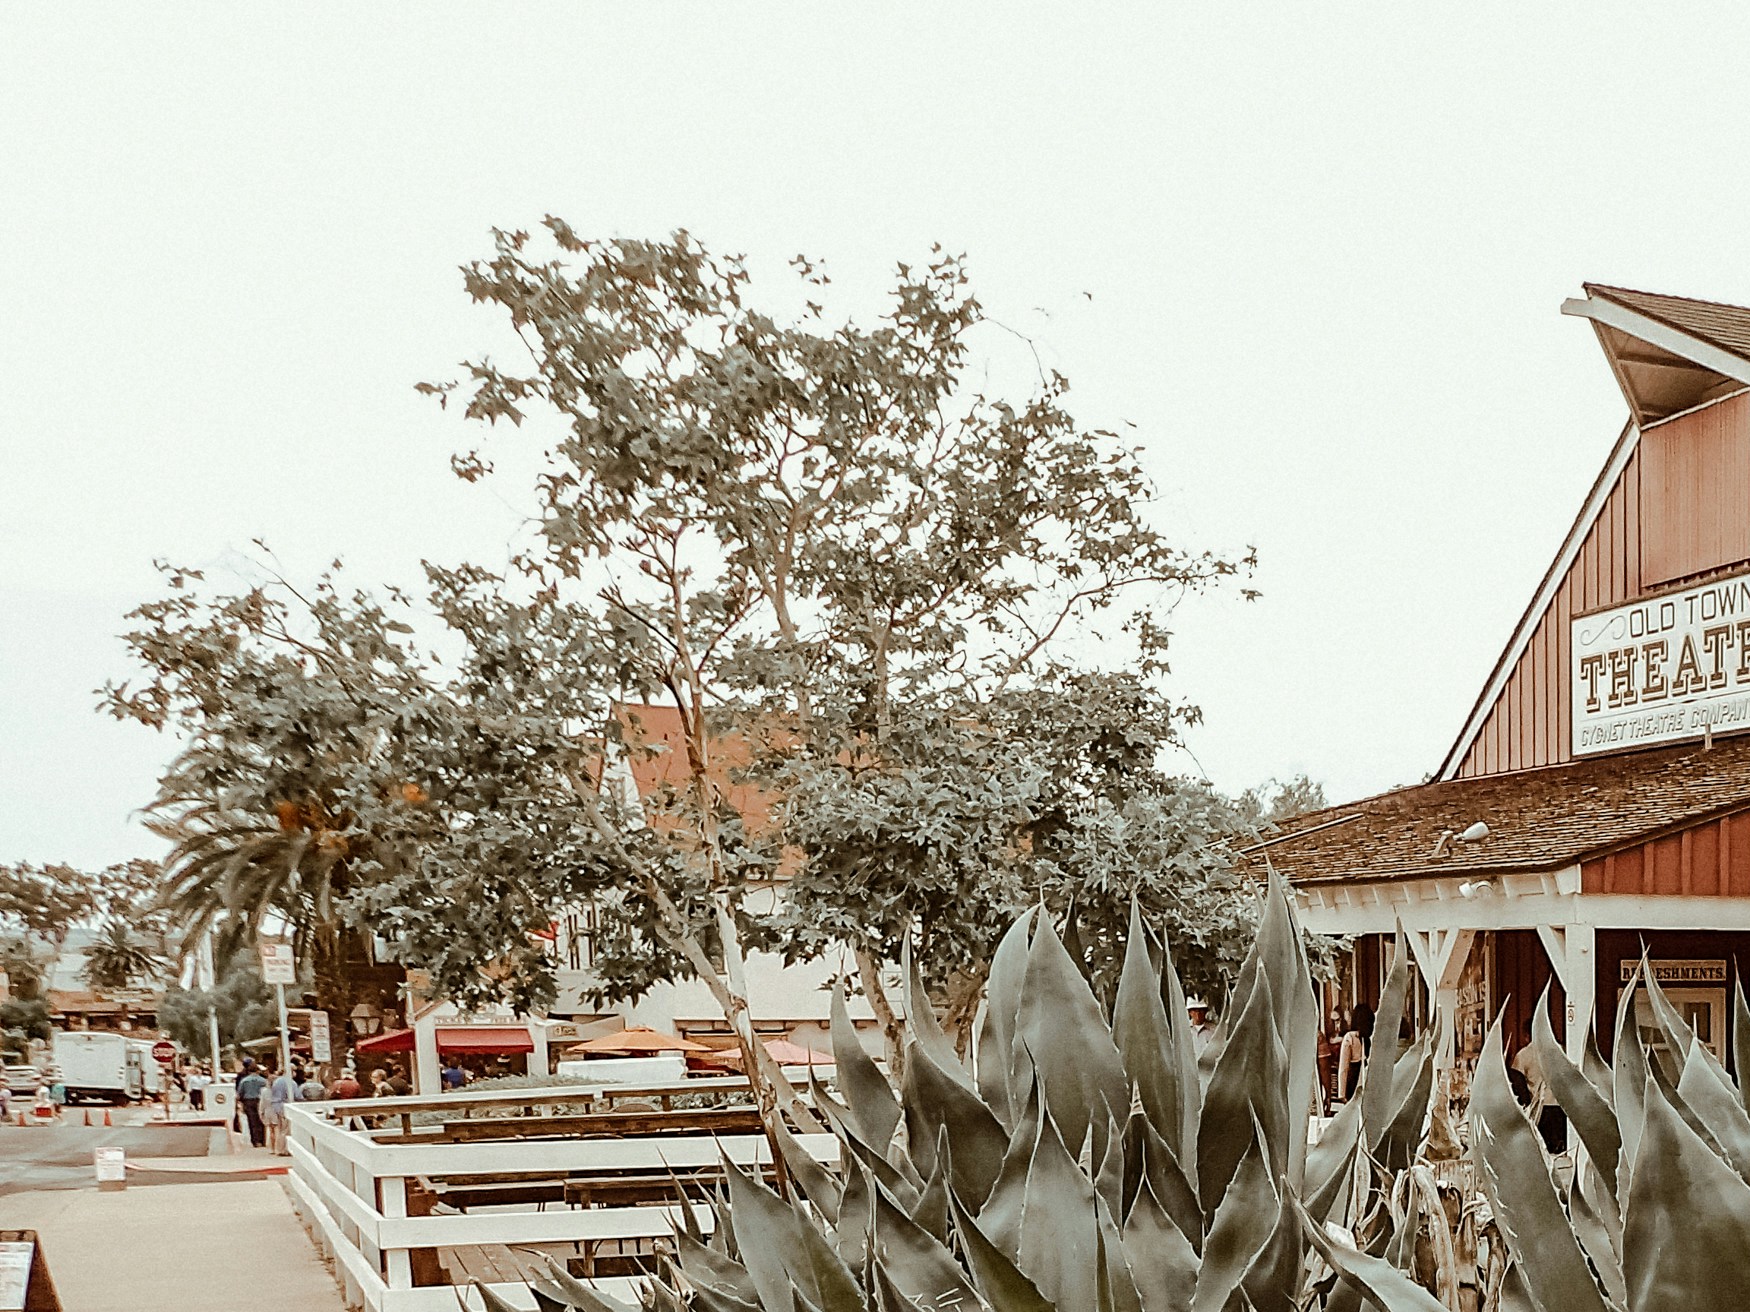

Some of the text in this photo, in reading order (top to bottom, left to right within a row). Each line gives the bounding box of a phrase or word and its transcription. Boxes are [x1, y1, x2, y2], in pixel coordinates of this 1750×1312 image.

[1629, 601, 1675, 638] OLD
[1581, 720, 1628, 747] CYGNET
[1628, 709, 1685, 740] THEATRE
